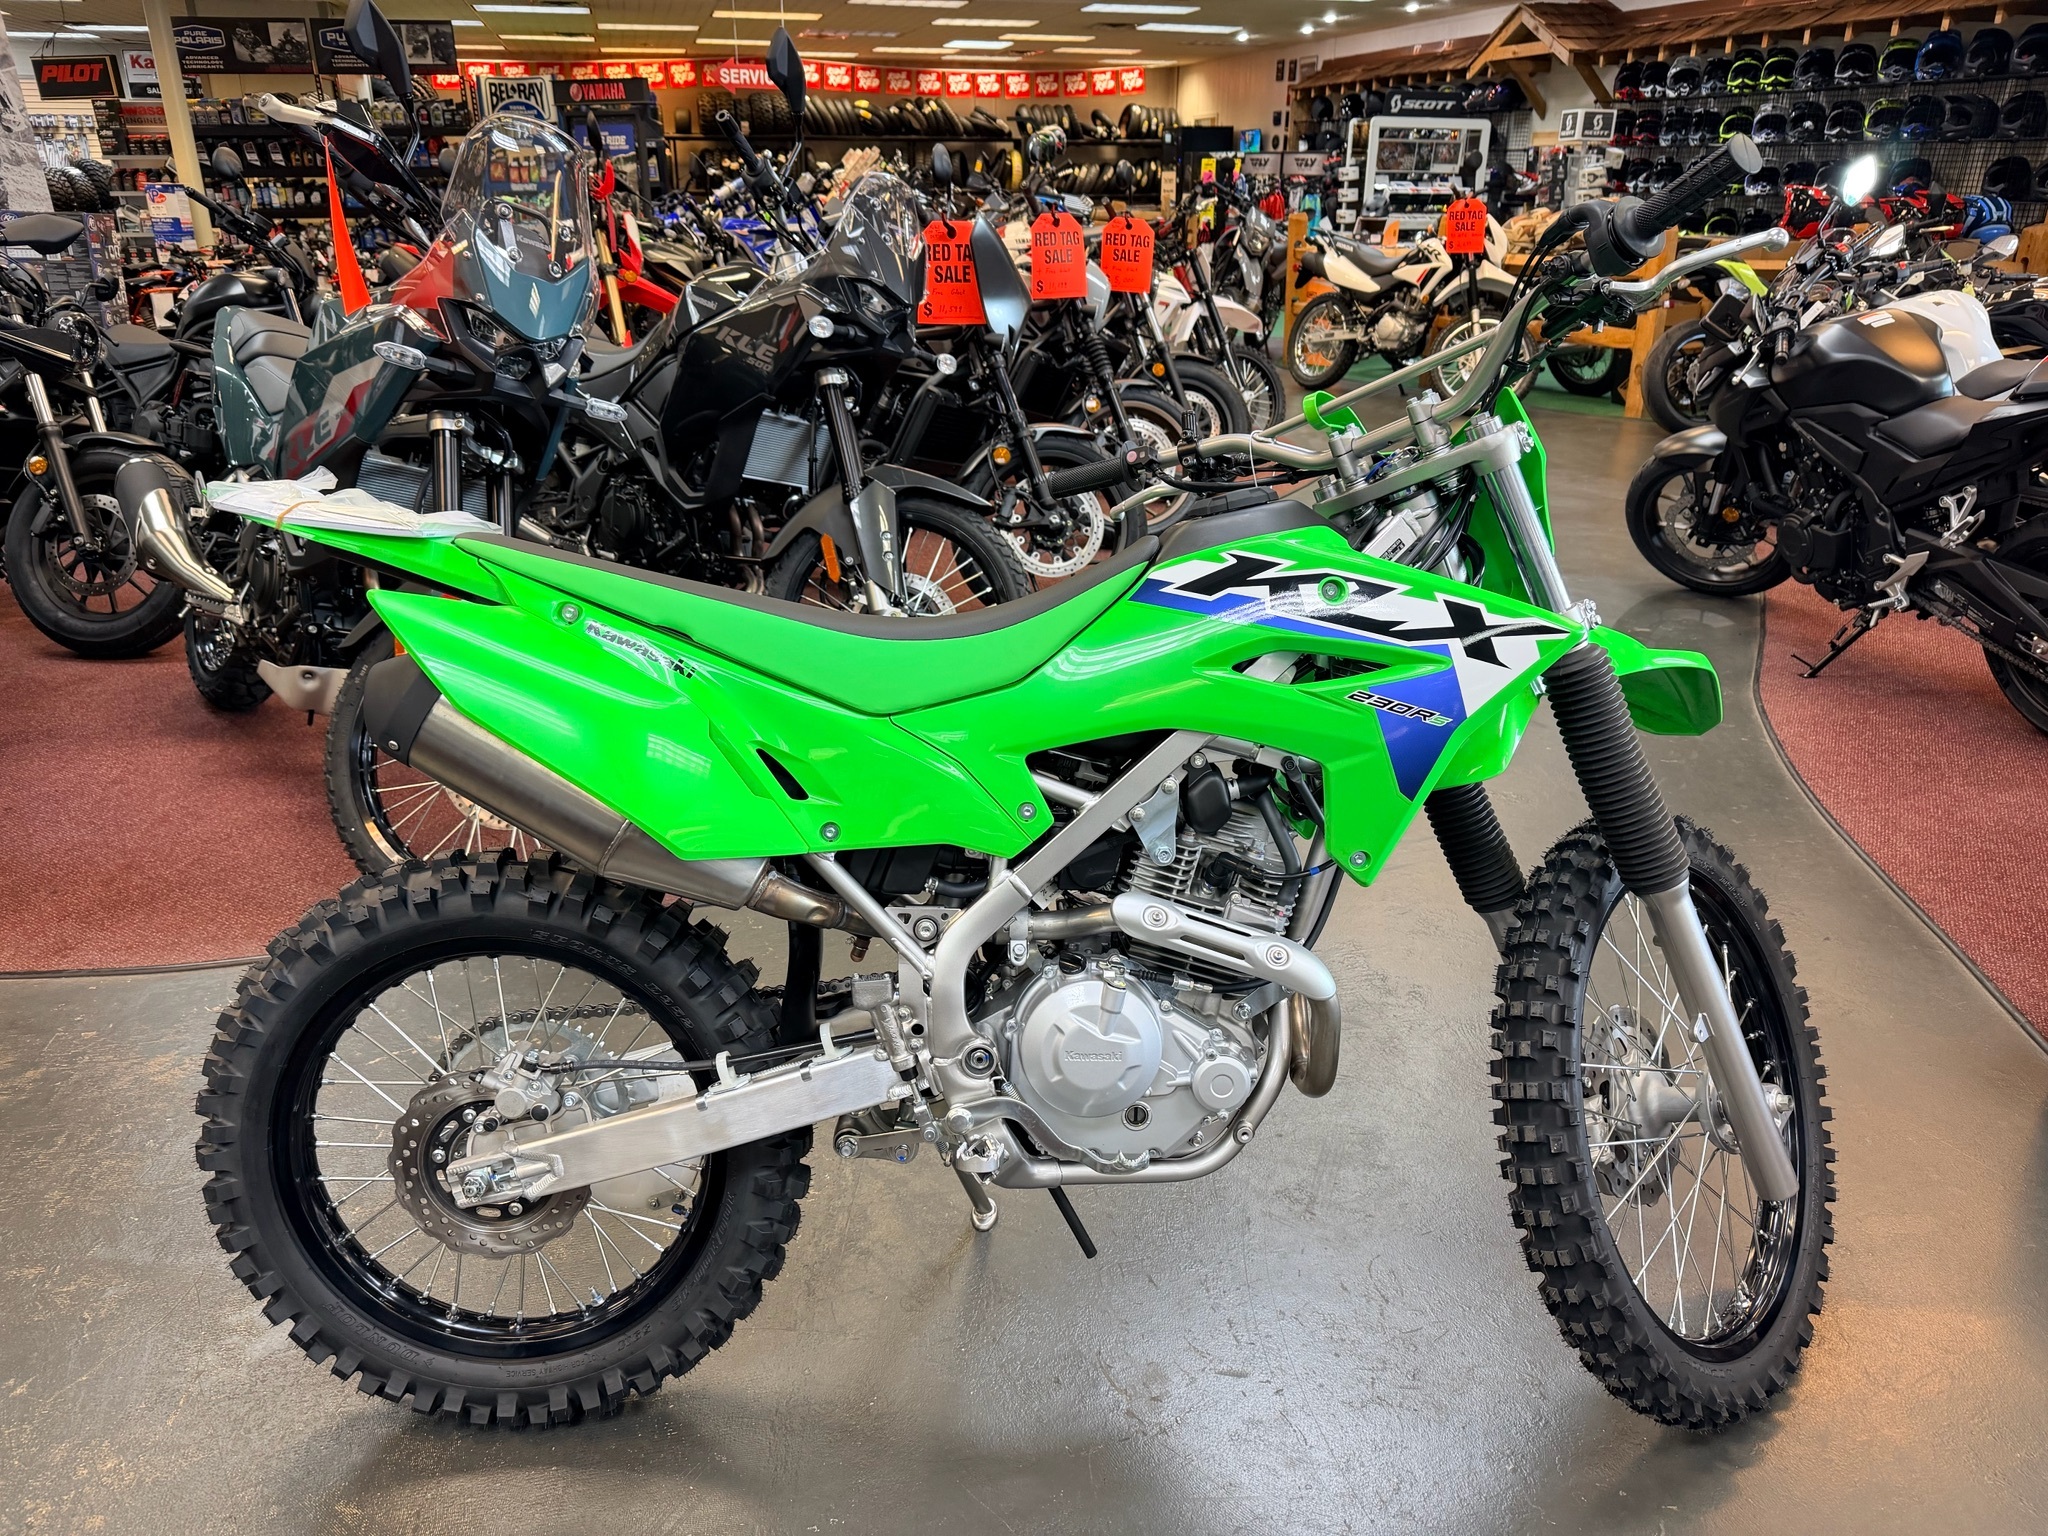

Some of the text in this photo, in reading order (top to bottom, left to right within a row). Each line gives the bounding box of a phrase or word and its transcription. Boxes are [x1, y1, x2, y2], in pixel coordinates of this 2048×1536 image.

[326, 32, 347, 41] PU
[41, 64, 103, 83] PILOT
[719, 68, 774, 86] SERVIC
[582, 82, 626, 100] YAMAHA
[1401, 100, 1457, 110] SCOTT
[606, 135, 627, 145] RIDE
[1449, 210, 1483, 220] RED TAG
[1455, 221, 1475, 231] SALE
[1034, 231, 1080, 247] RED TAG
[1105, 232, 1150, 248] RED TAG
[927, 243, 973, 262] RED TA
[1044, 249, 1073, 264] SALE
[1112, 248, 1141, 263] SALE
[934, 265, 972, 284] SALE
[1036, 279, 1044, 294] $
[923, 301, 933, 318] $
[715, 326, 778, 363] KLE
[586, 619, 697, 680] Kawasaki
[1064, 1050, 1123, 1062] Kawasaki
[506, 1368, 537, 1378] SERVICE
